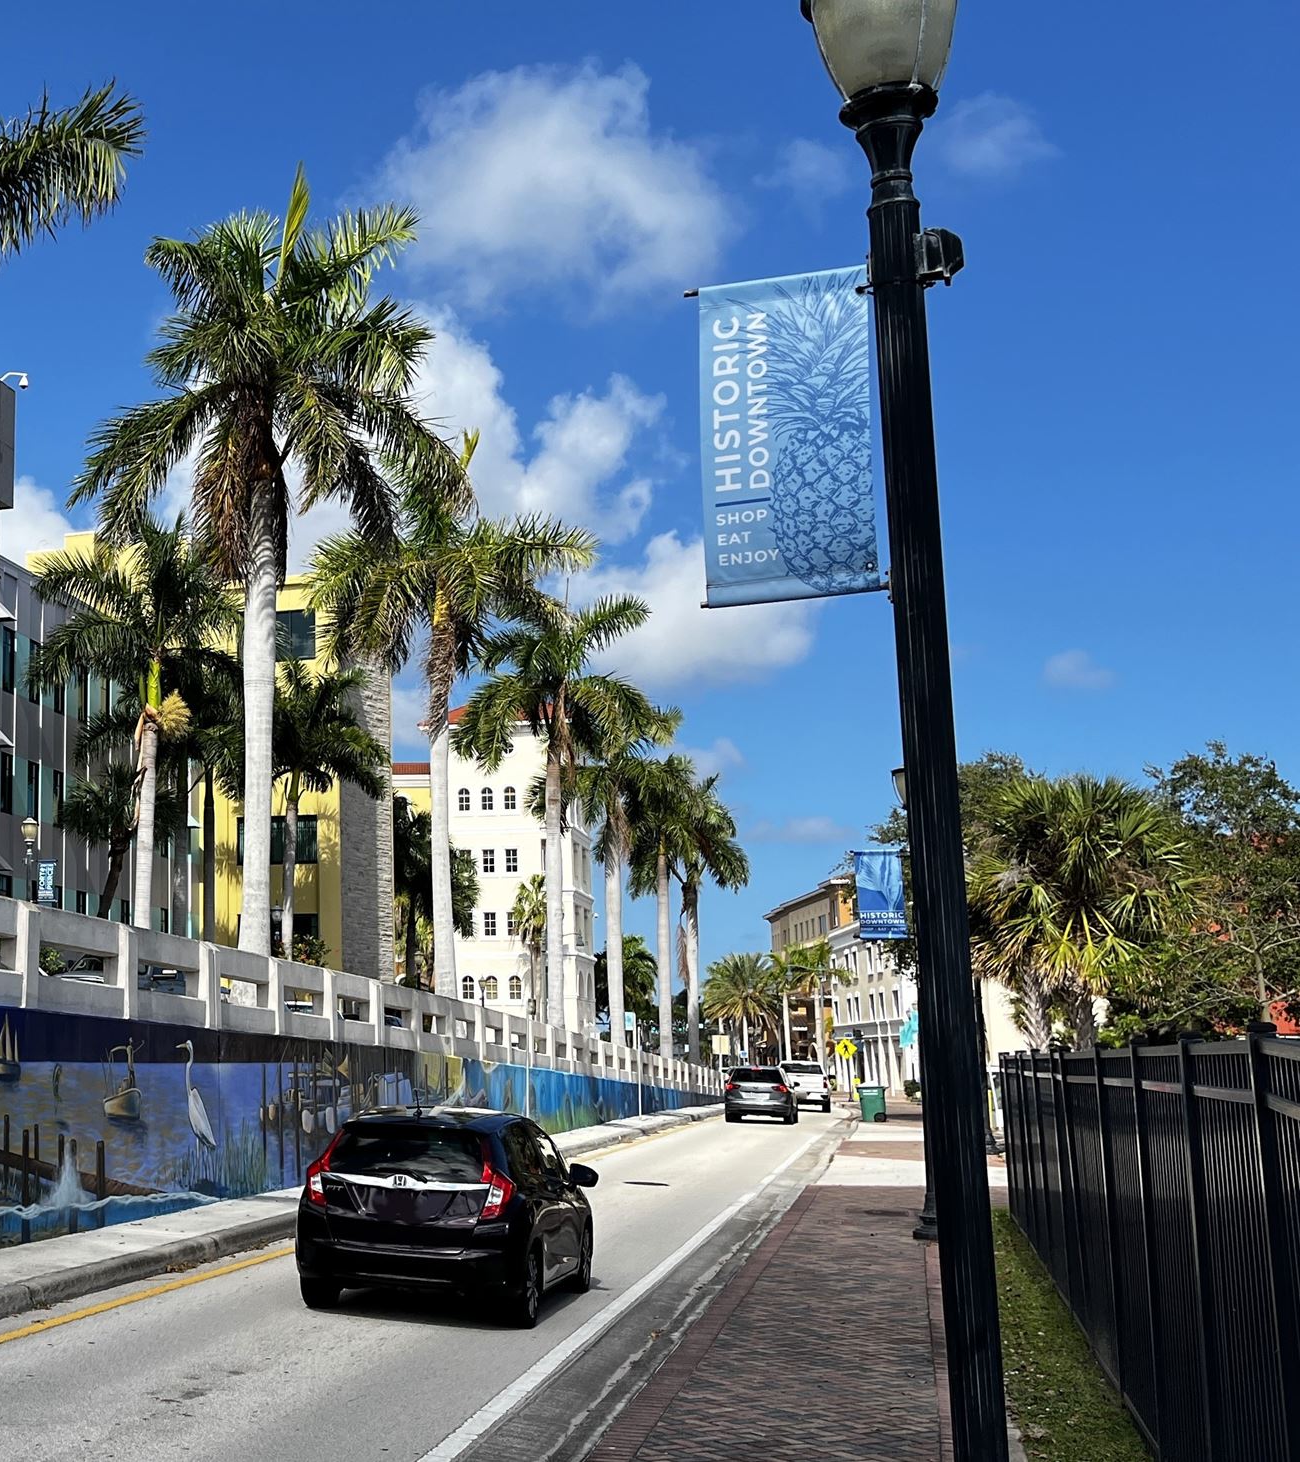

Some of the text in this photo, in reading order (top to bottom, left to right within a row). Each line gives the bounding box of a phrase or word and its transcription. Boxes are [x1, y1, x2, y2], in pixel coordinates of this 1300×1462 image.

[713, 315, 742, 492] HISTORIC
[747, 312, 771, 490] DOWNTOWN
[715, 509, 768, 526] SHOP
[717, 531, 752, 546] EAT
[718, 549, 780, 566] ENJOY
[325, 1184, 344, 1192] FIT
